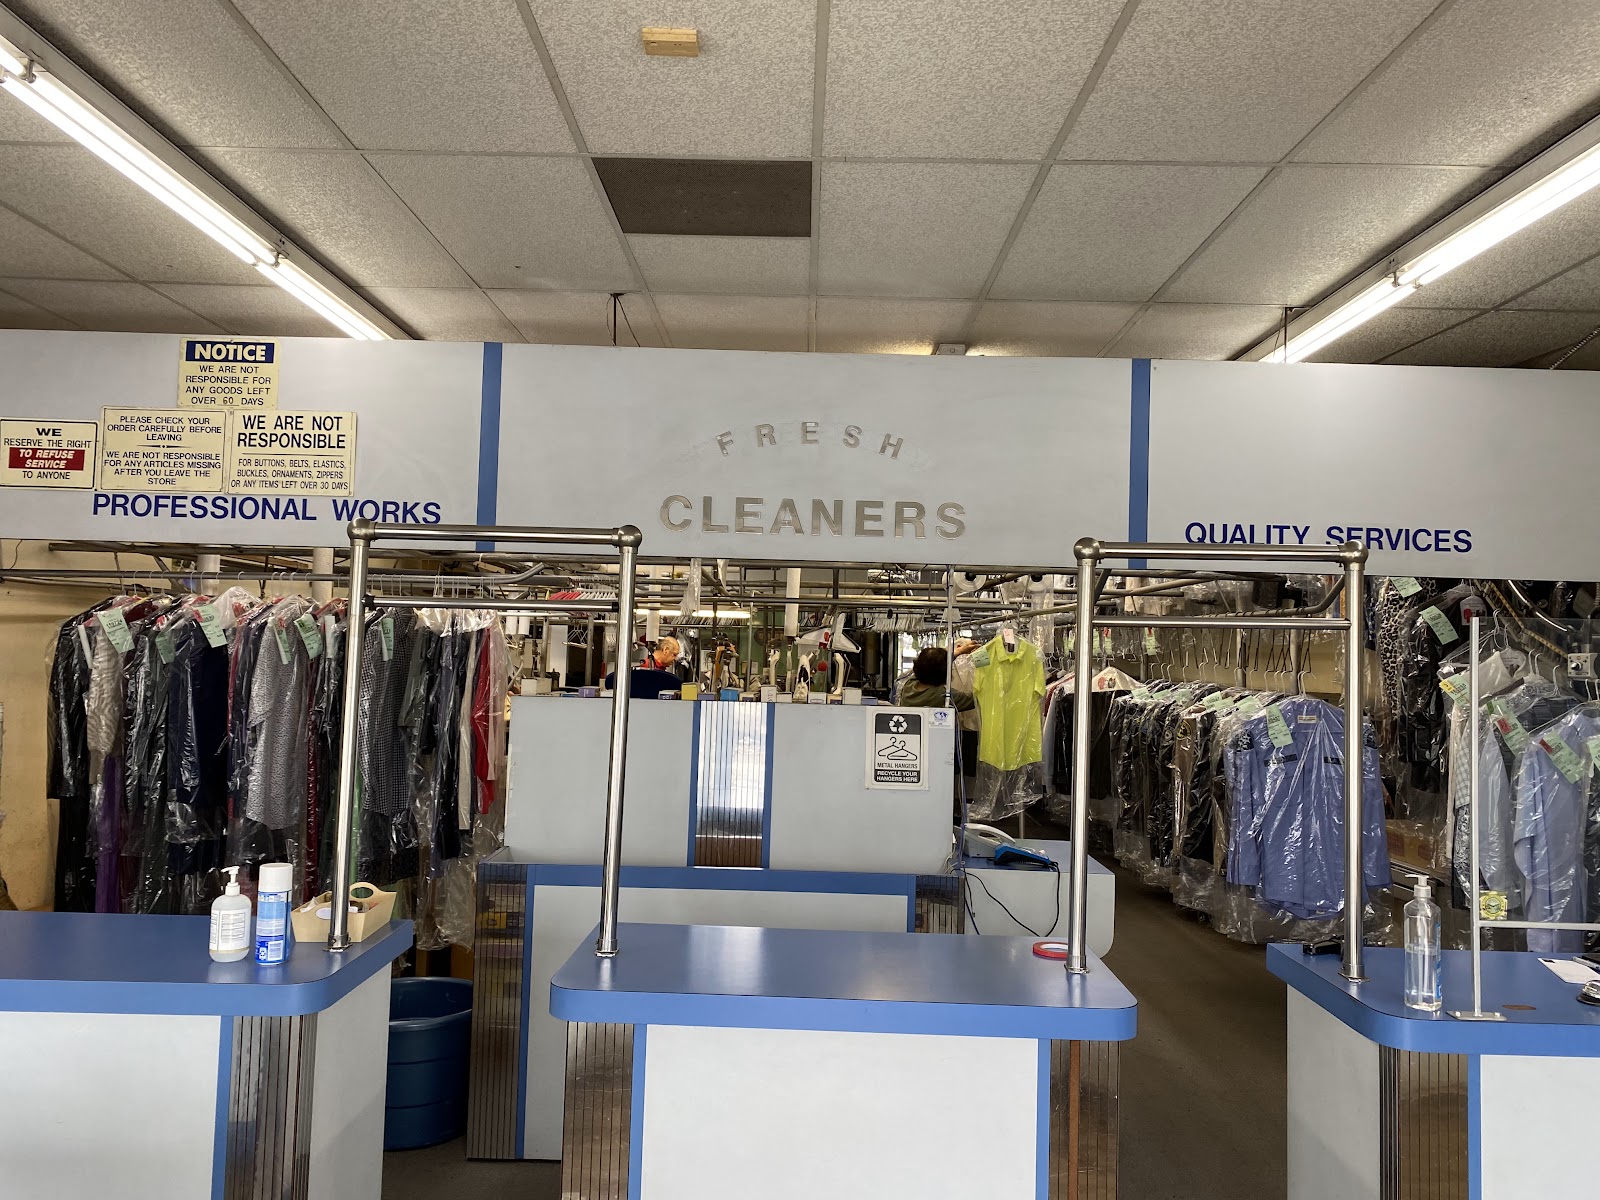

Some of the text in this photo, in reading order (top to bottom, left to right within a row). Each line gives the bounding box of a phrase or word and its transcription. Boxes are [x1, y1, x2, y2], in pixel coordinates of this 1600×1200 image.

[194, 343, 267, 361] NOTICE
[199, 365, 259, 374] WE ARE NOT
[185, 375, 271, 385] RESPONSIBLE FOR
[209, 386, 243, 395] GOODS
[247, 387, 271, 395] LEFT
[191, 396, 264, 406] OVER 60 DAYS
[119, 415, 210, 425] PLEASE CHECK YOUR
[242, 414, 343, 431] WE ARE NOT
[36, 427, 62, 437] WE
[107, 424, 222, 434] ORDER CAREFULLY BEFORE
[146, 433, 182, 441] LEAVING
[237, 432, 346, 449] RESPONSIBLE
[715, 421, 904, 460] FRESH
[3, 437, 92, 448] RESERVE THE RIGHT
[19, 449, 75, 459] TO REFUSE
[106, 451, 120, 459] WE
[122, 451, 140, 459] ARE
[163, 452, 220, 461] RESPONSIBLE
[25, 459, 67, 469] SERVICE
[104, 459, 122, 467] FOR
[187, 461, 221, 469] MISSING
[238, 458, 346, 470] FOR BUTTONS, BELTS, ELASTICS,
[22, 470, 71, 480] TO ANYONE
[114, 468, 142, 476] AFTER
[164, 469, 191, 477] LEAVE
[237, 469, 343, 480] BUCKLES, ORNAMENTS, ZIPPERS
[147, 477, 177, 485] STORE
[230, 479, 349, 490] OR ANY ITEMS LEFT OVER 30 DAYS
[93, 493, 441, 524] PROFESSIONAL WORKS
[659, 494, 966, 540] CLEANERS
[1185, 522, 1473, 553] QUALITY SERVICES
